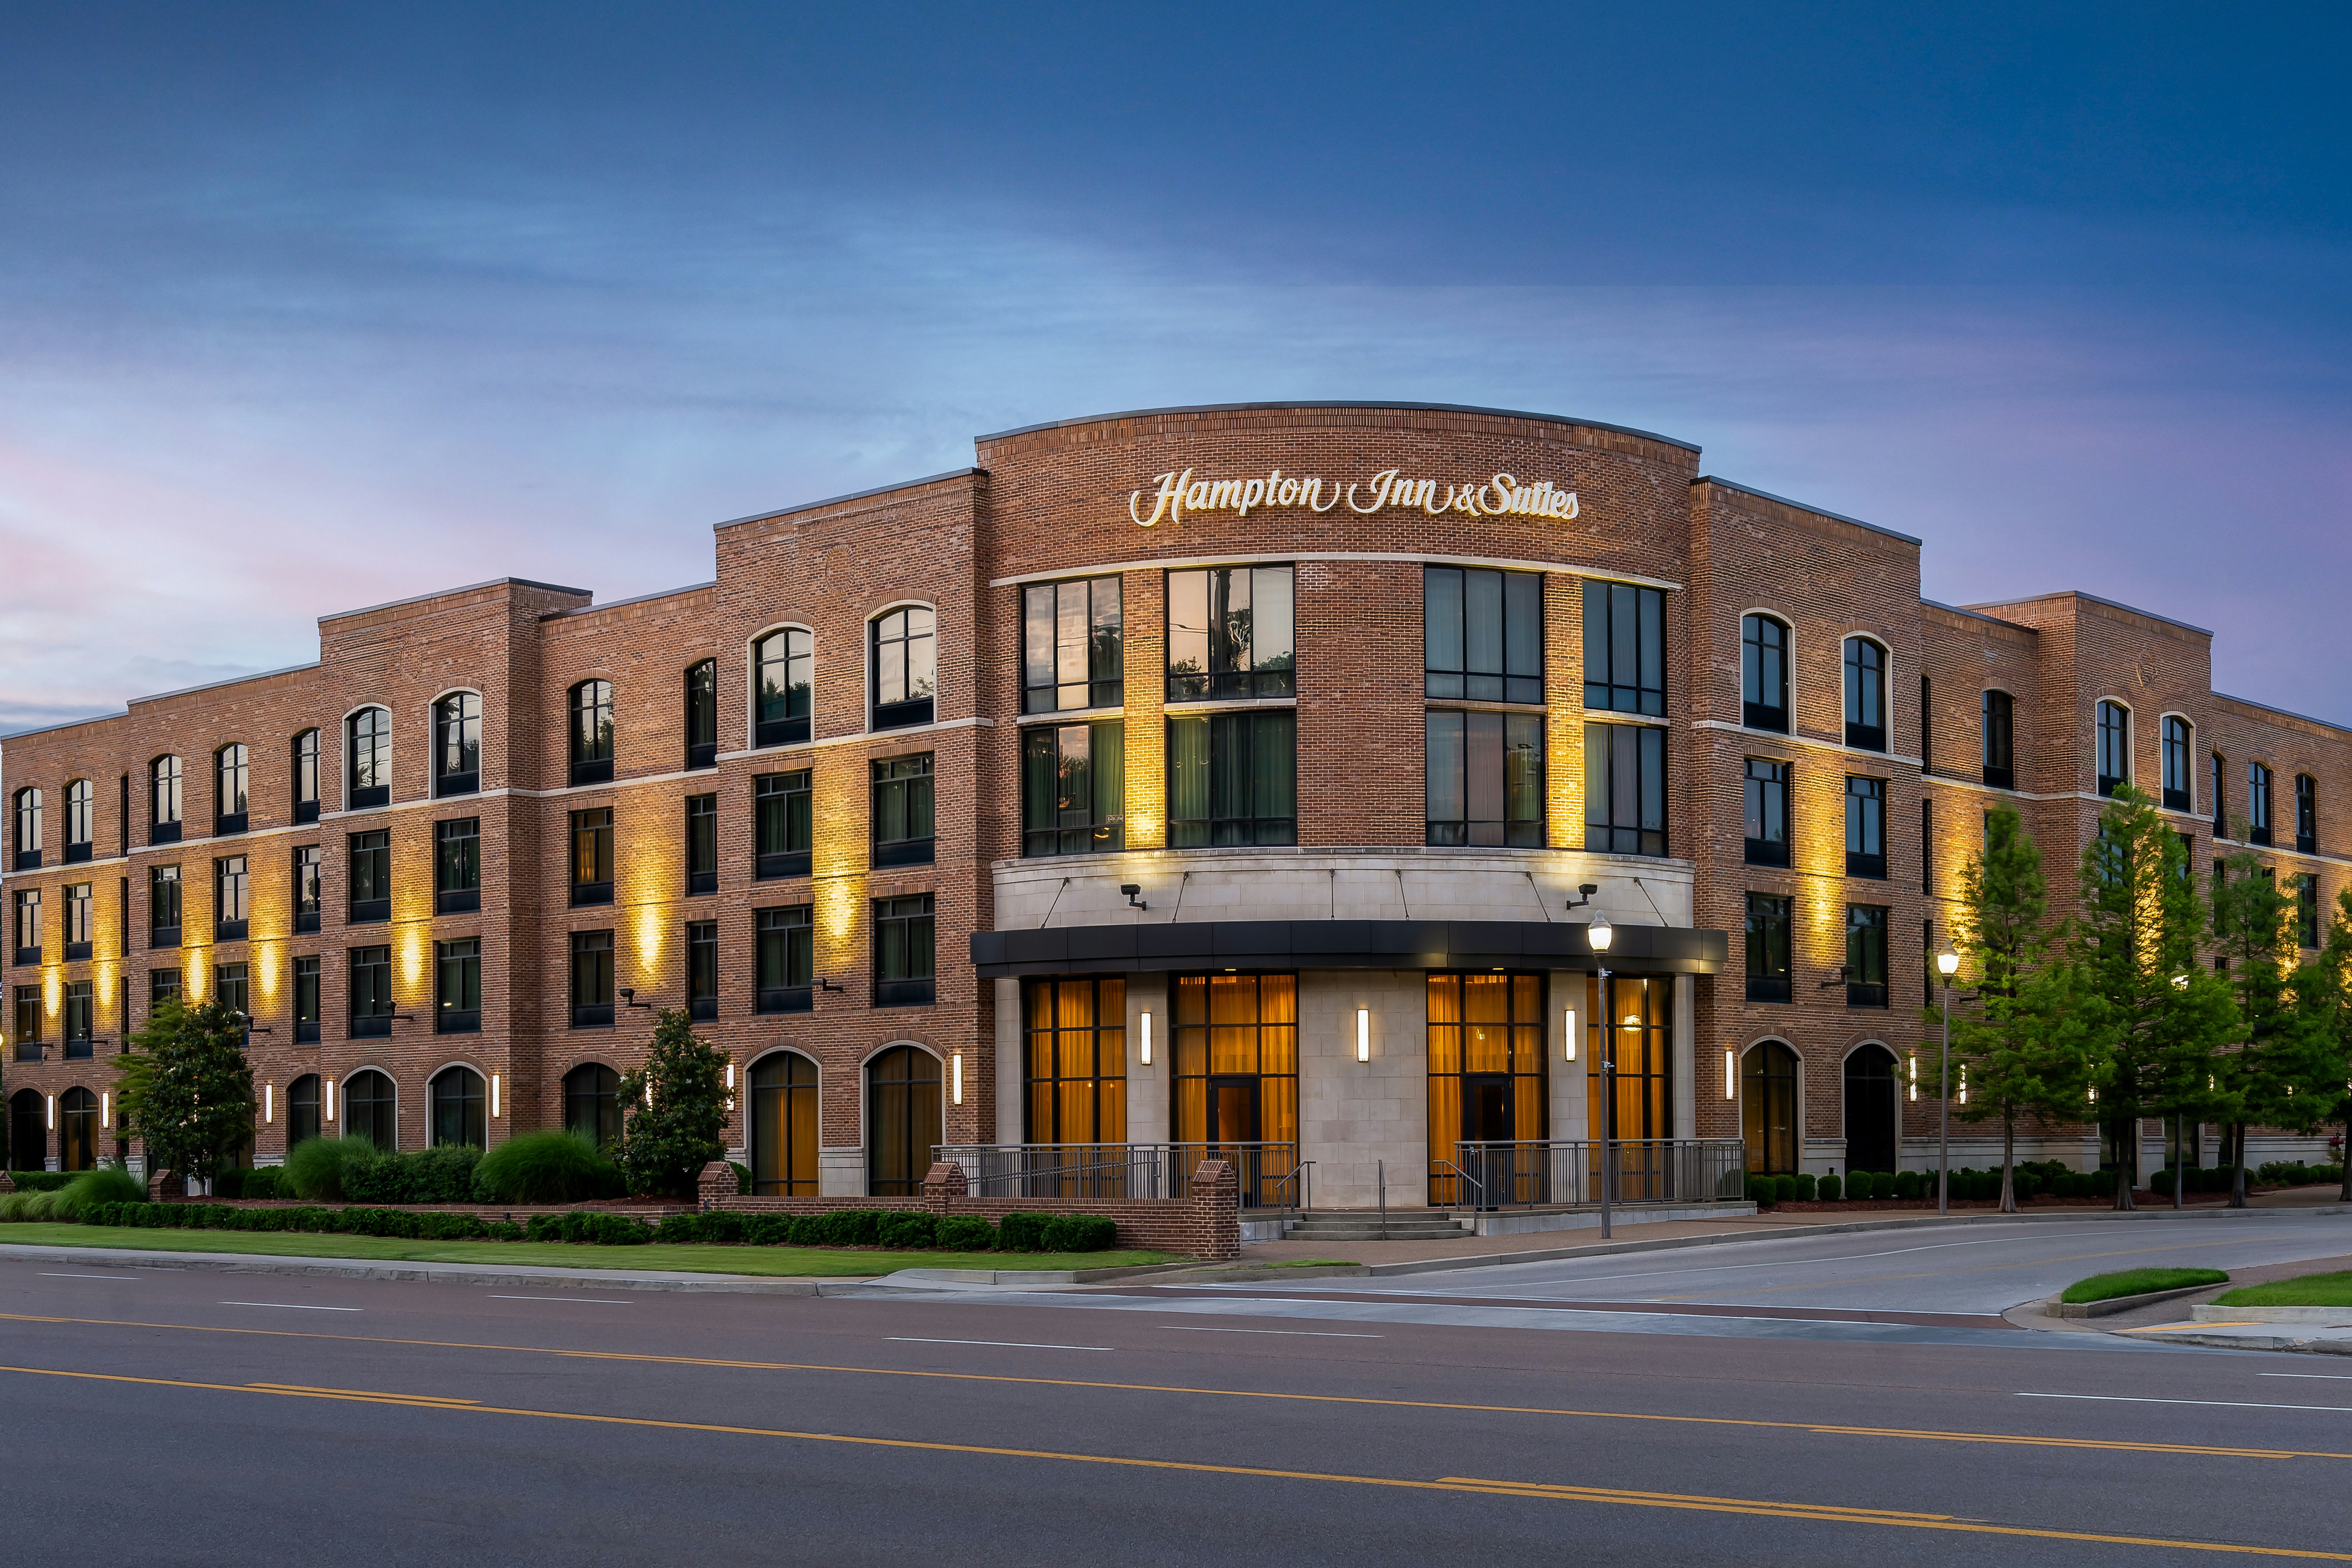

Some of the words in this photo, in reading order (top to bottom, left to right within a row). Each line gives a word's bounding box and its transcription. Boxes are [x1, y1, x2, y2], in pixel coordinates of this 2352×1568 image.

[1130, 467, 1340, 527] Hampton
[1348, 469, 1454, 515] Inn
[1455, 483, 1481, 516] &
[1479, 473, 1579, 520] Suites
